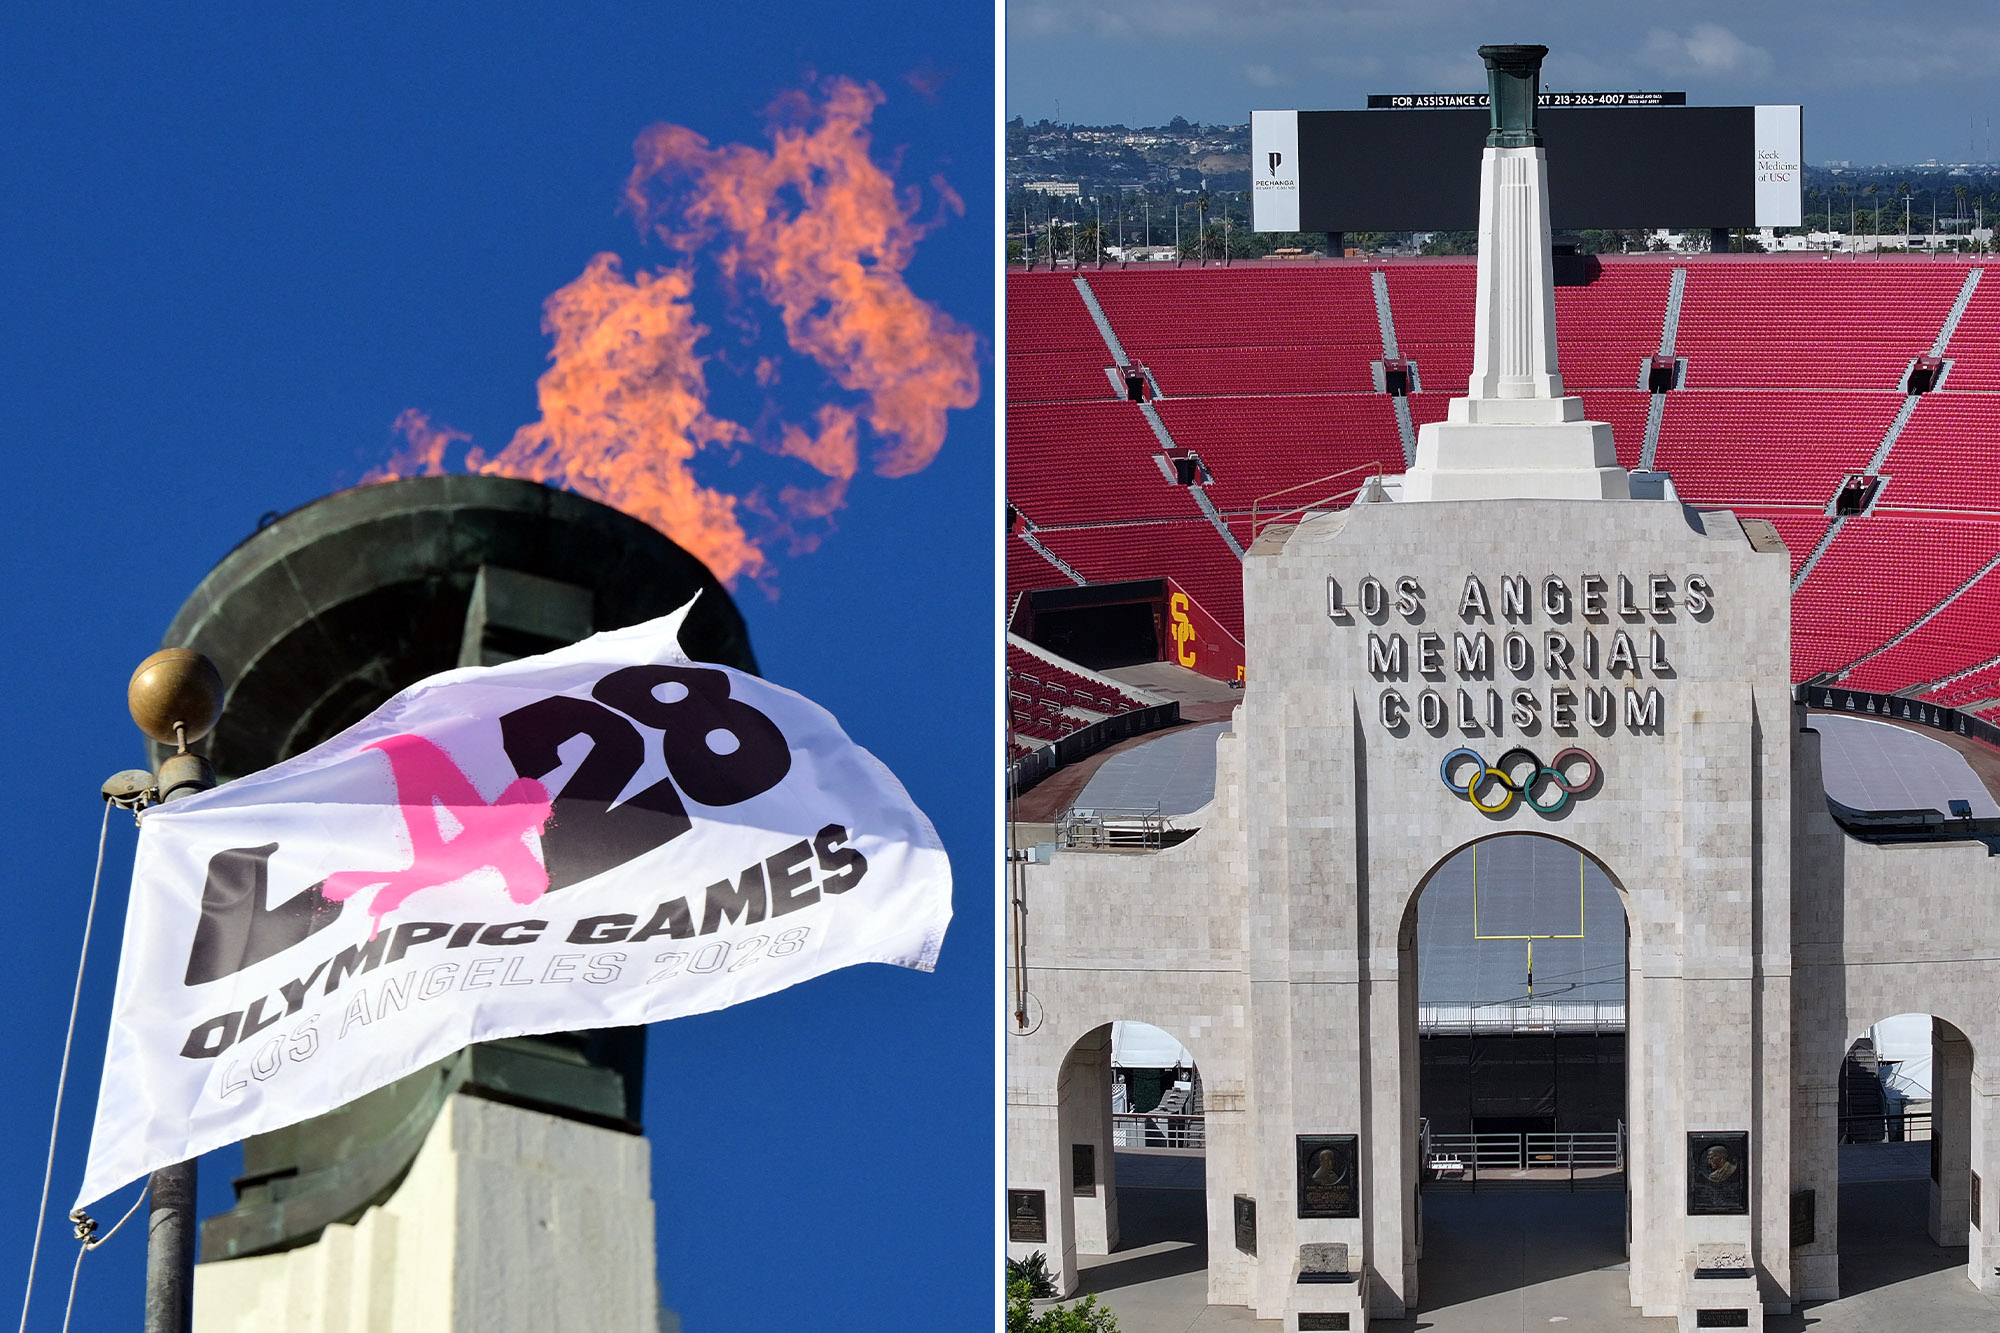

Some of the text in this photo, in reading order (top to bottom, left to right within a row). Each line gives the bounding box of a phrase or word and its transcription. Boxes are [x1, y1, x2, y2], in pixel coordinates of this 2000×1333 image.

[1392, 97, 1412, 107] FOR
[1416, 96, 1475, 106] ASSISTANCE
[1554, 94, 1625, 105] 213-263-4007
[1758, 149, 1780, 159] Keck
[1758, 161, 1798, 171] Medicine
[1758, 172, 1791, 182] of USC
[1327, 573, 1708, 617] LOS ANGELES
[1171, 592, 1196, 668] SC
[1368, 630, 1669, 673] MEMORIAL
[1379, 687, 1658, 729] COLISEUM
[179, 823, 868, 1059] OLYMPIC GAMES
[220, 926, 811, 1099] LOS ANGELES 2028
